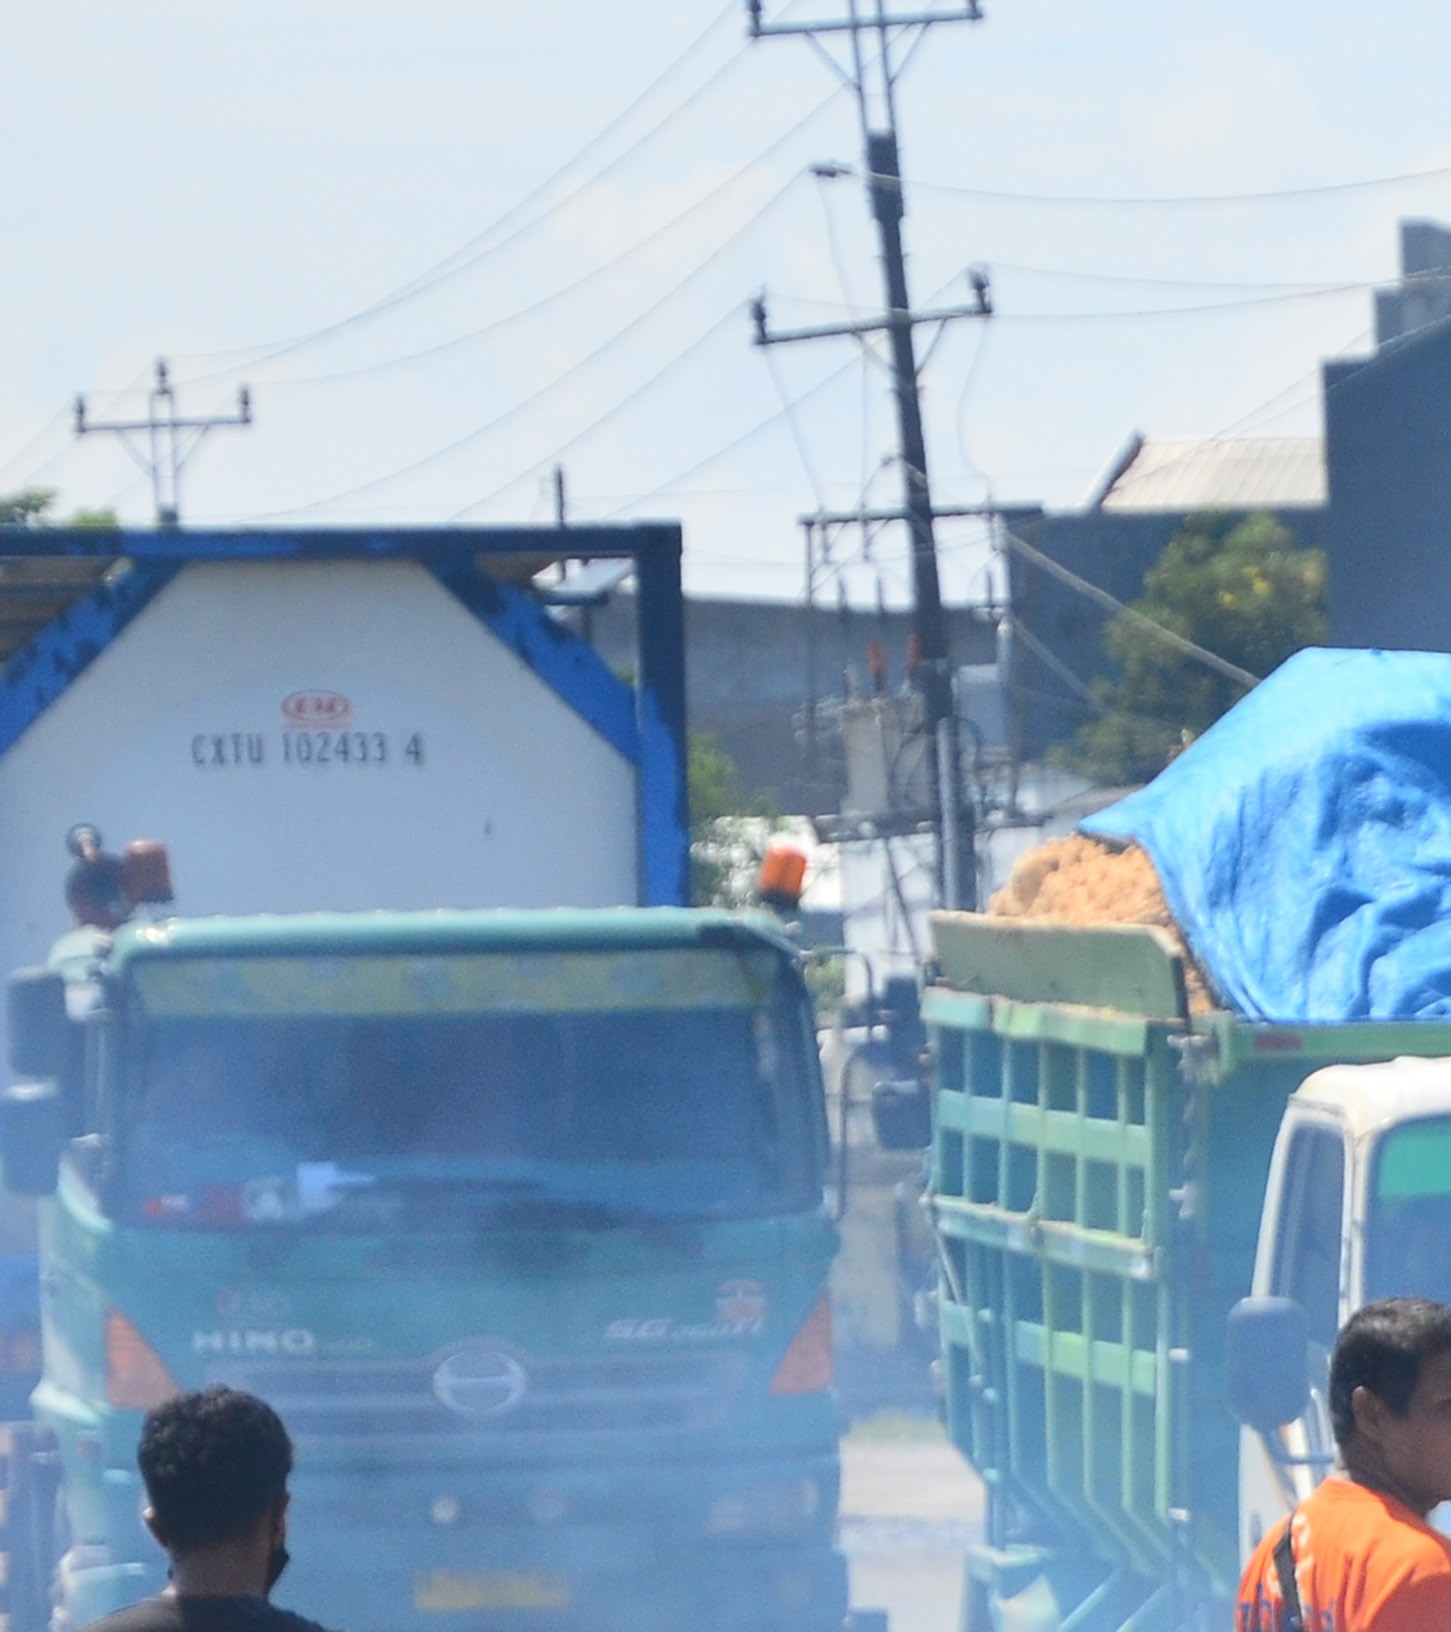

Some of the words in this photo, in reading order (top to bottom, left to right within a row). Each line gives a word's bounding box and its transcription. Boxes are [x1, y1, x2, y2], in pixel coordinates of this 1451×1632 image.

[192, 733, 263, 765] CXTU
[282, 731, 386, 763] 102433
[405, 733, 424, 765] 4
[192, 1328, 317, 1352] HINO
